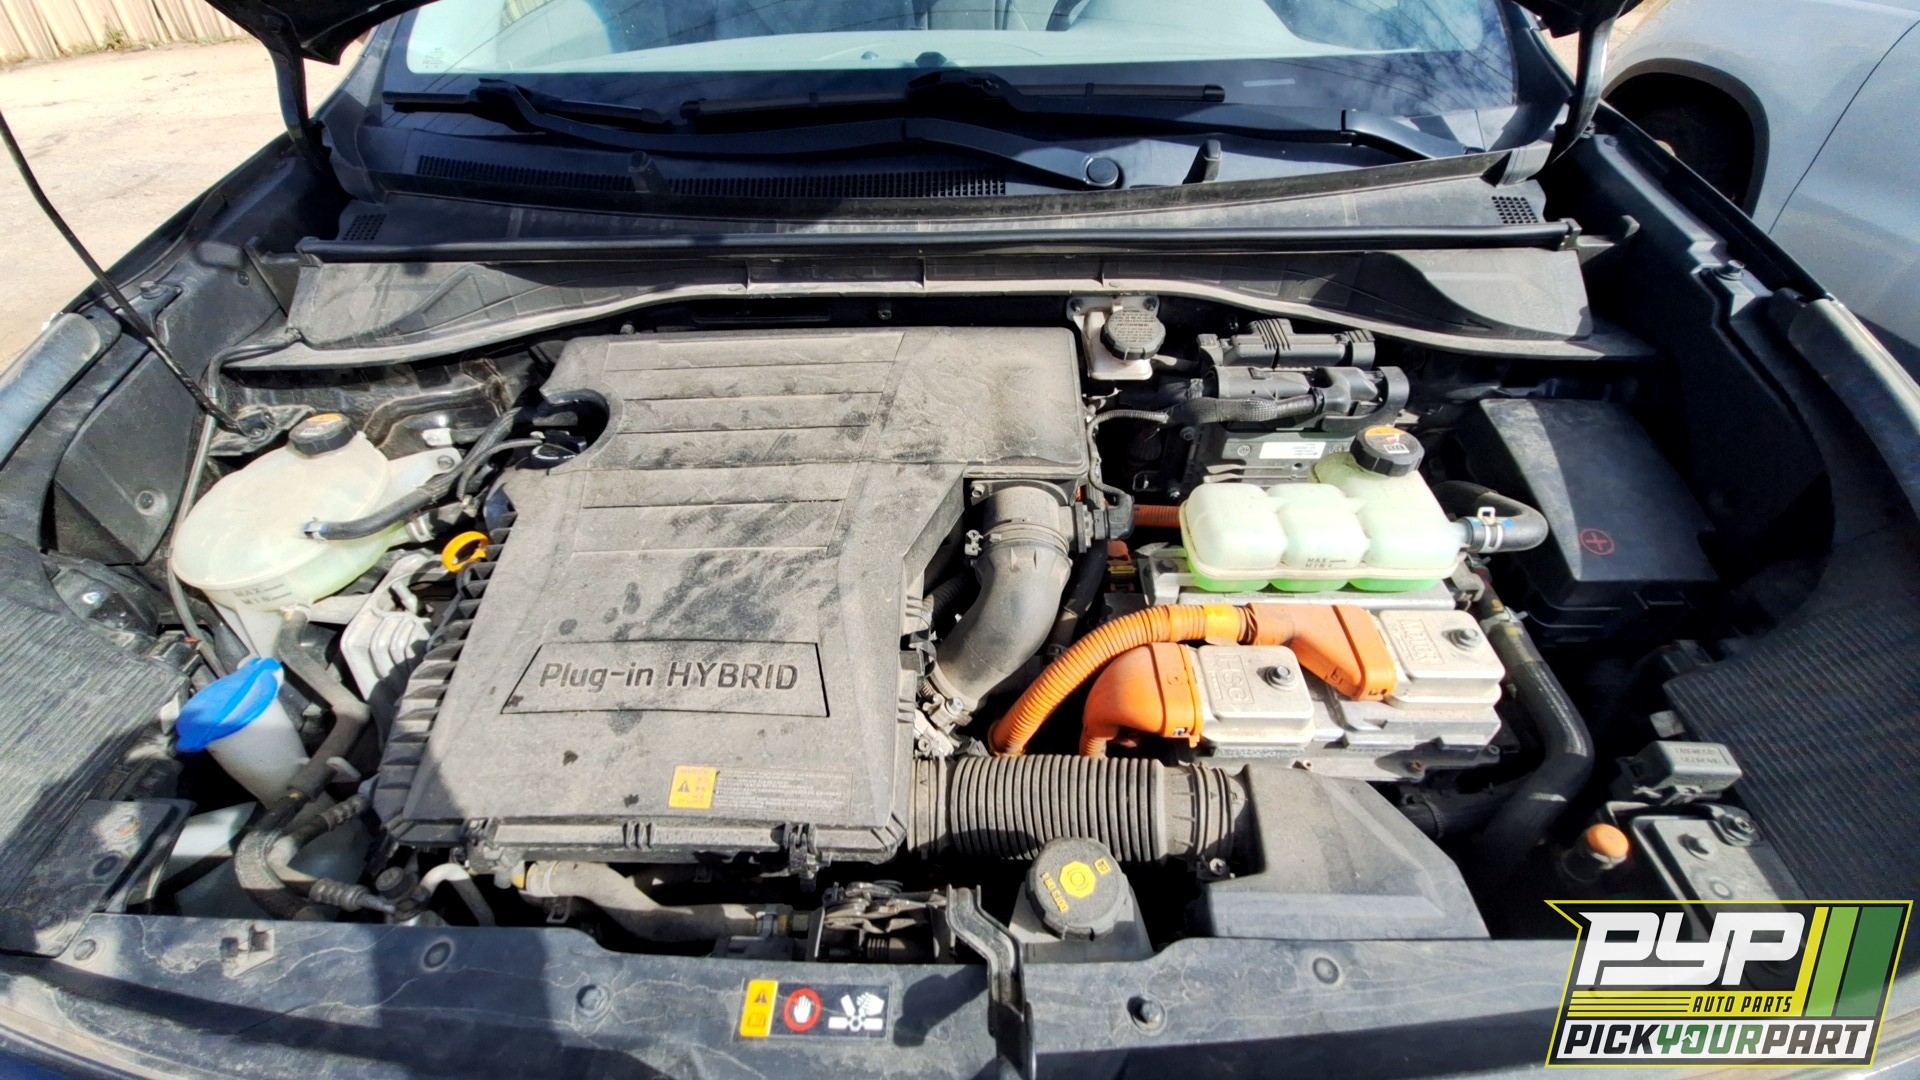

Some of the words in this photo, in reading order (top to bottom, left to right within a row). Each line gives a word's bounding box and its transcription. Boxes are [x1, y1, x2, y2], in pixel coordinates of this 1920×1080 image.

[233, 588, 262, 597] MAX
[539, 662, 654, 693] Plug-in
[667, 662, 797, 689] HYBRID
[1216, 658, 1250, 701] HSG
